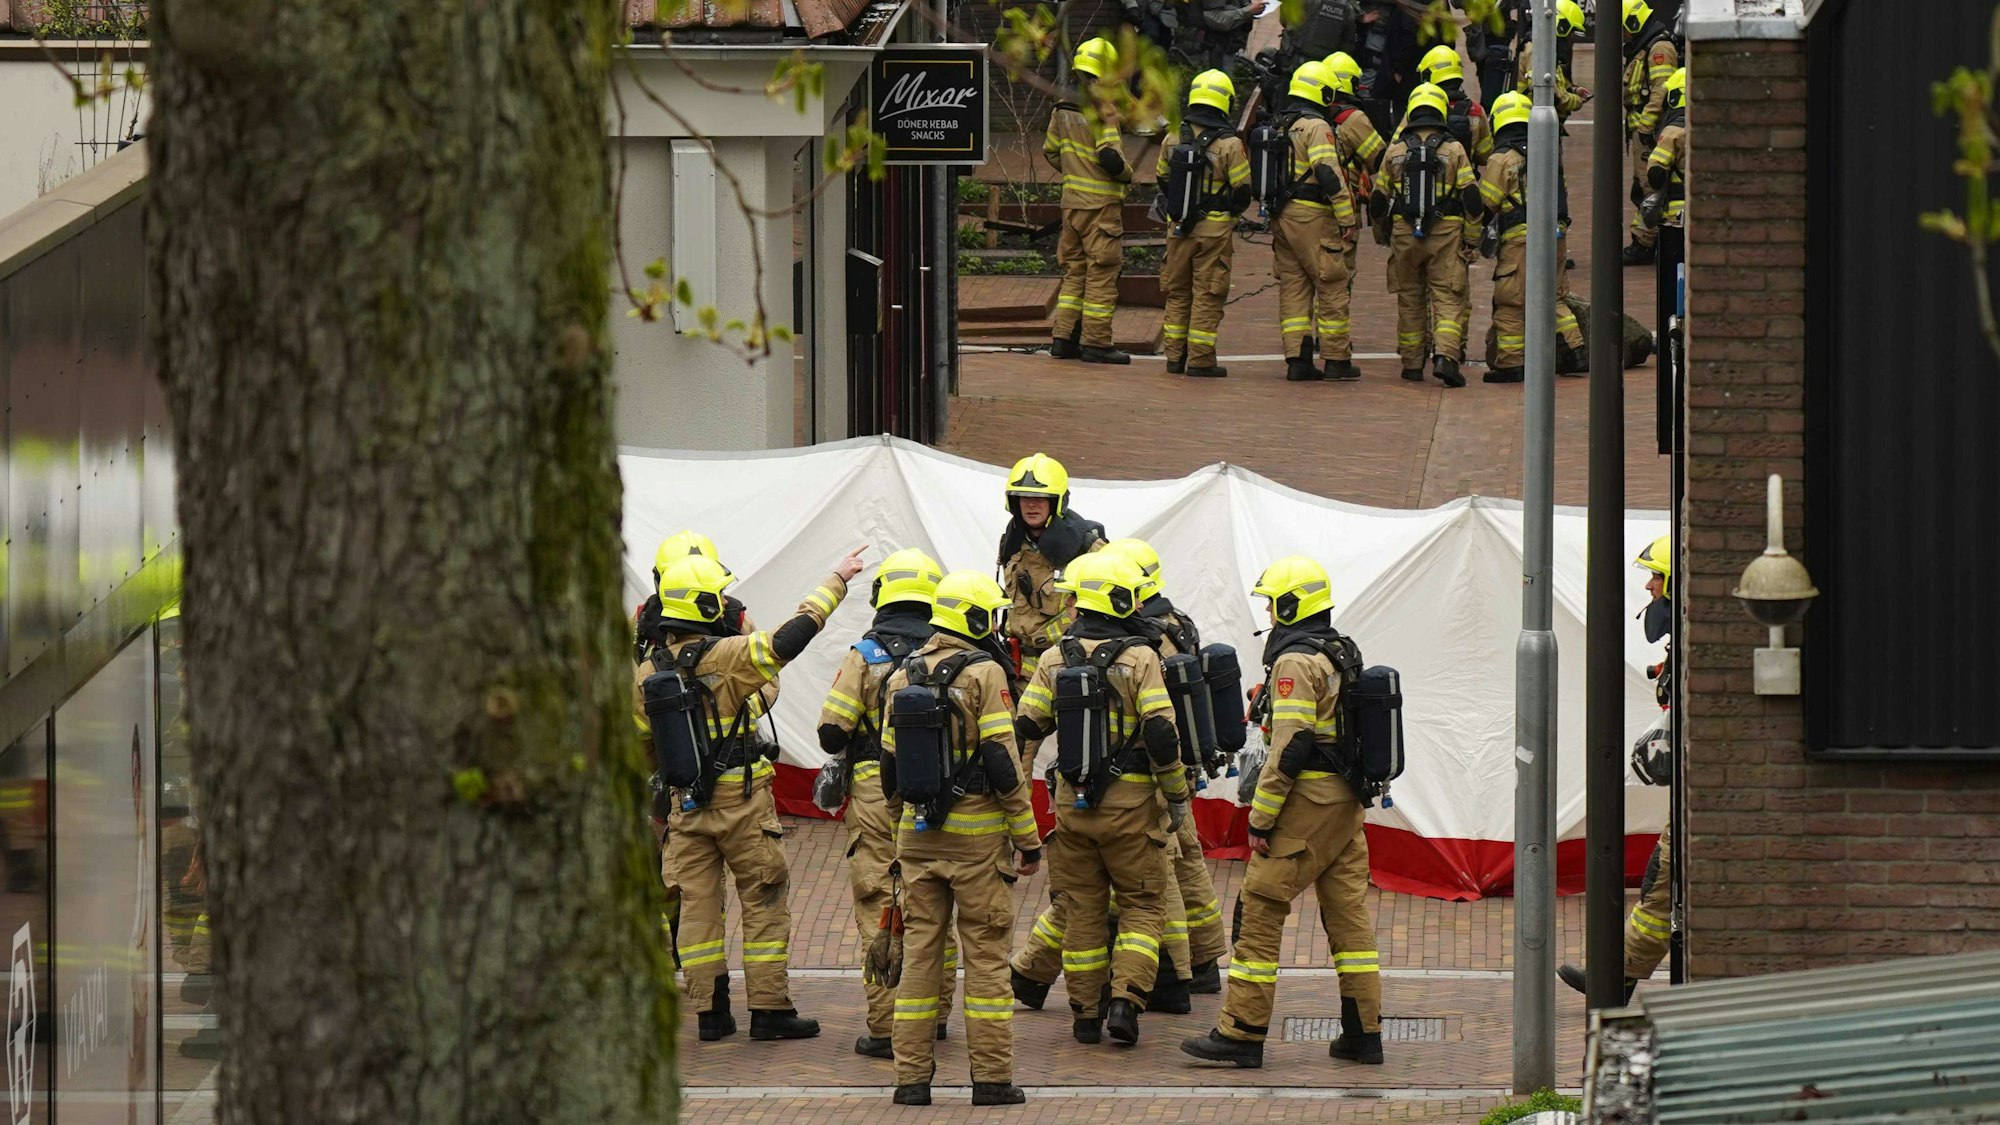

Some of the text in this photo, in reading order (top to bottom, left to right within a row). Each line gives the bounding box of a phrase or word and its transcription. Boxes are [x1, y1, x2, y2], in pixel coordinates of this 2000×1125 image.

[897, 117, 959, 129] DÖNER KEBAB
[910, 130, 946, 140] SNACKS
